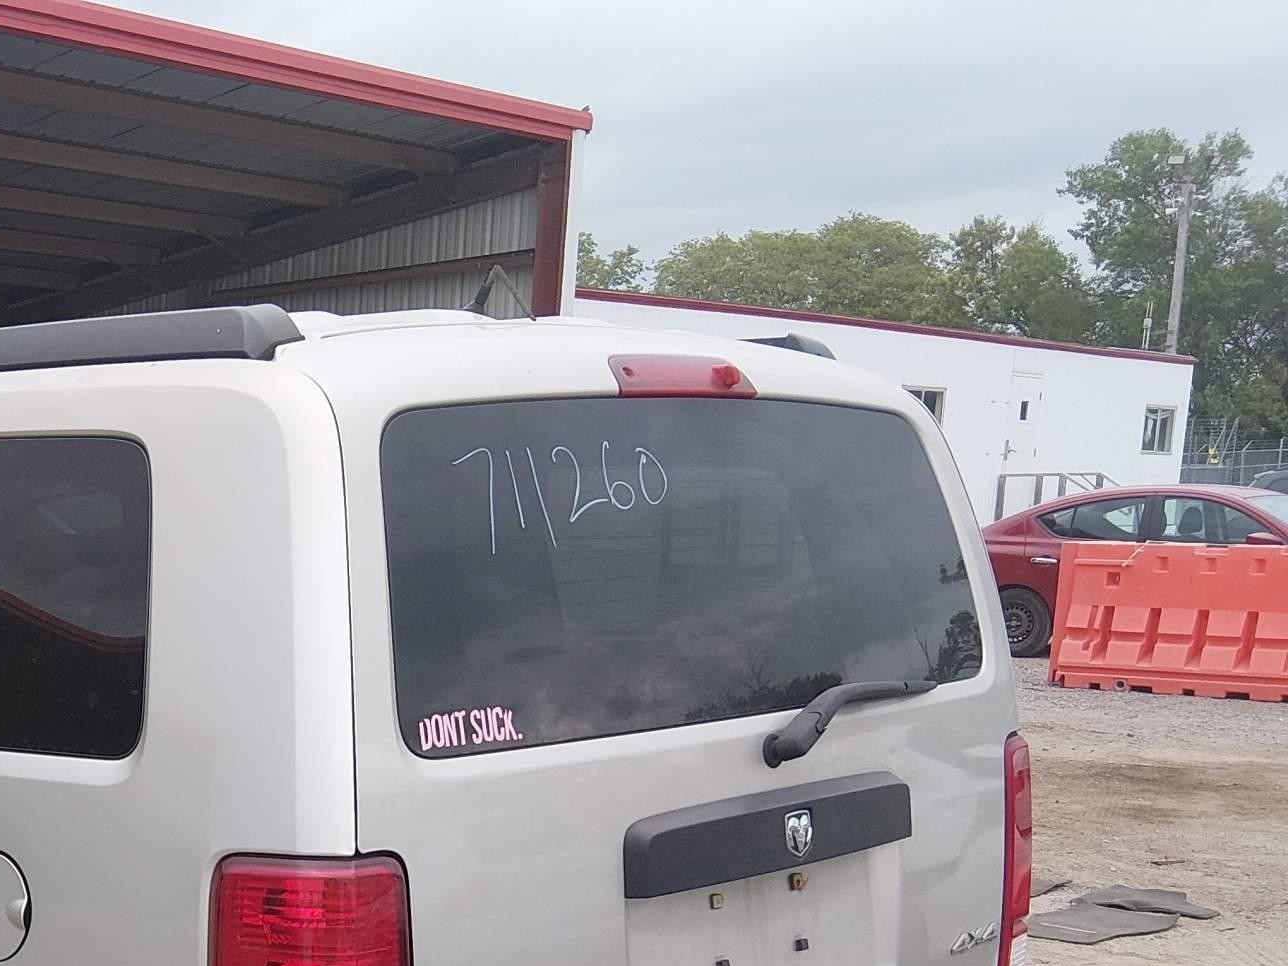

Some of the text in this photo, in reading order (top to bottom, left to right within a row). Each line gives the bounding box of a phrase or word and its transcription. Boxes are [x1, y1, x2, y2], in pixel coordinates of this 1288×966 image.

[452, 440, 668, 554] 711260
[418, 706, 524, 752] DONT SUCK.
